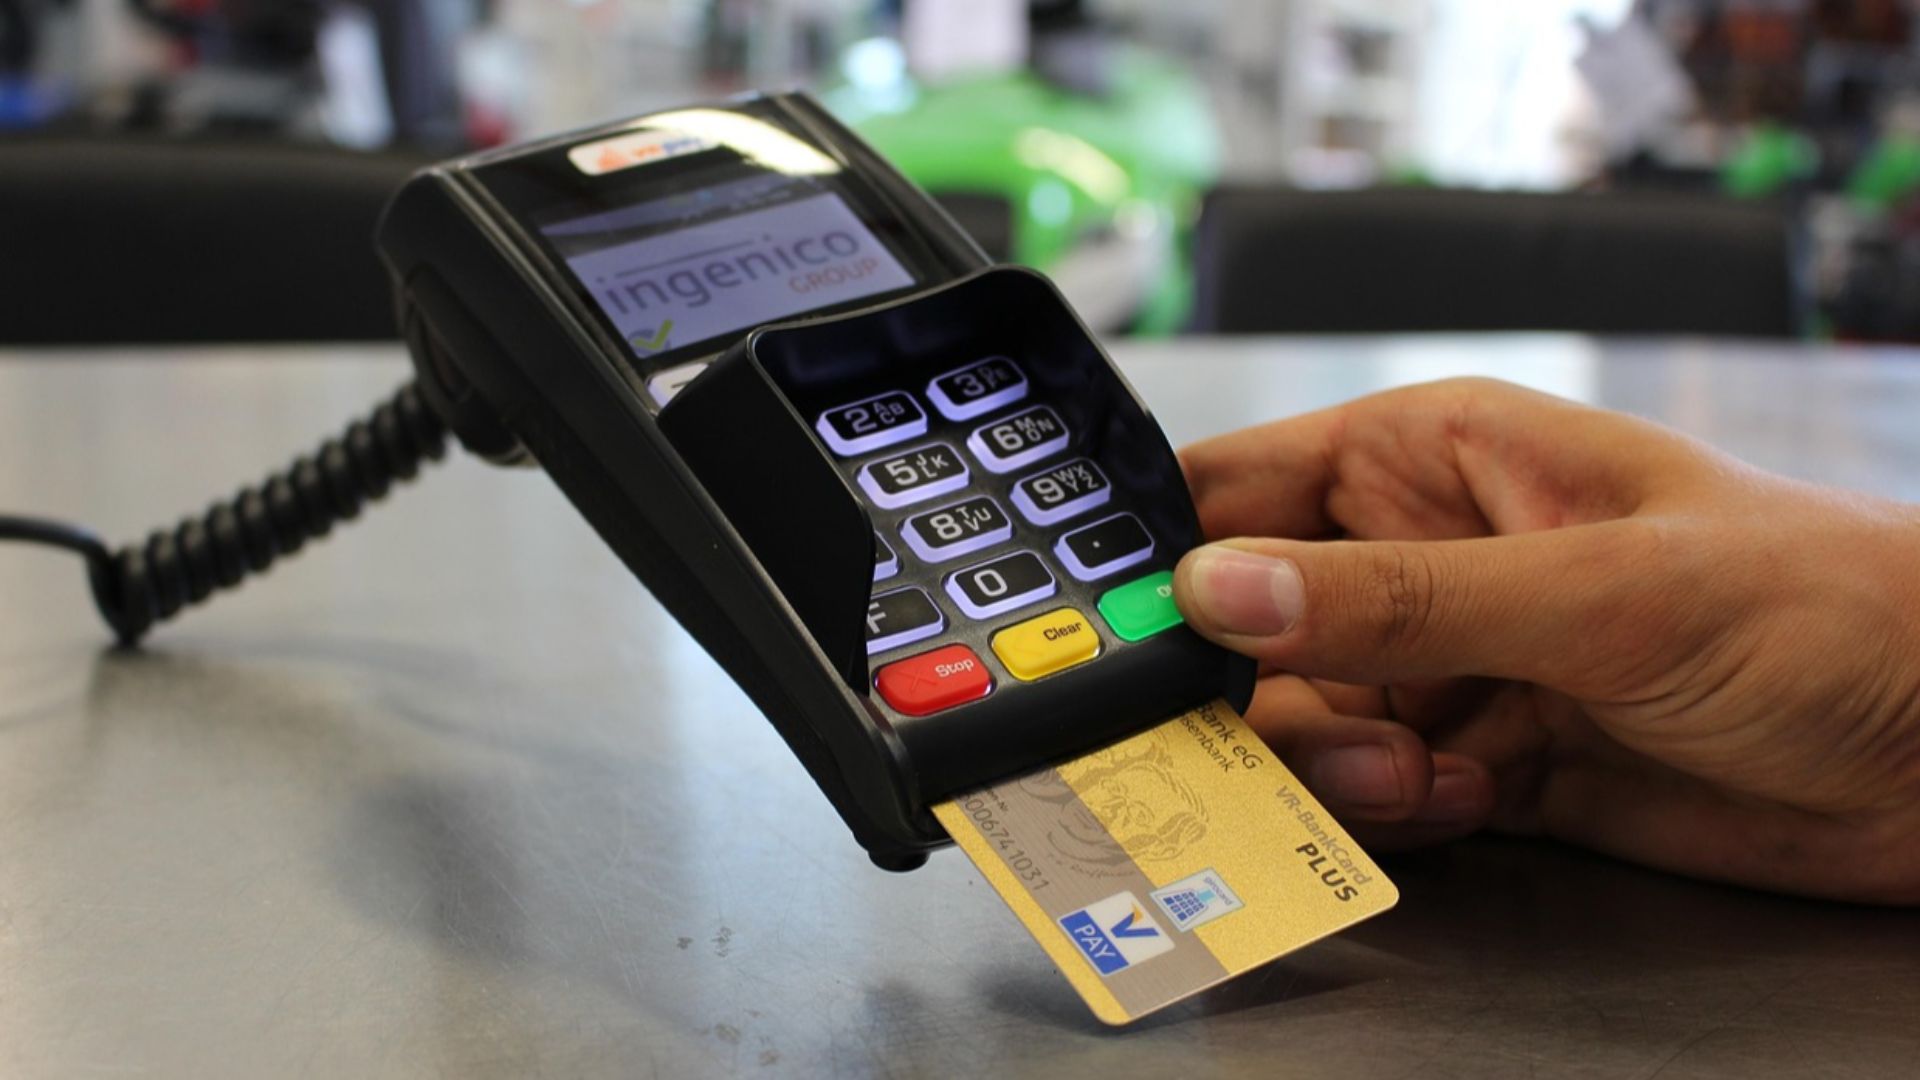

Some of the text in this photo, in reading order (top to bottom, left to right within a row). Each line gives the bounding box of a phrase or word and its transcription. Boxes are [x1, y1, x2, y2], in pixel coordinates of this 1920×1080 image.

[596, 230, 860, 314] ingenico
[788, 255, 879, 294] GROUP
[953, 373, 986, 397] 3
[843, 407, 878, 434] 2
[991, 425, 1024, 450] 6
[884, 459, 919, 486] 5
[1031, 477, 1066, 503] 9
[929, 513, 963, 540] 8
[1156, 584, 1173, 598] O
[1042, 621, 1083, 641] Clear
[935, 658, 975, 678] Stop
[1232, 745, 1264, 769] eG
[1275, 784, 1373, 886] VR-BankCard
[1295, 841, 1359, 902] PLUS
[1074, 924, 1117, 958] PAY
